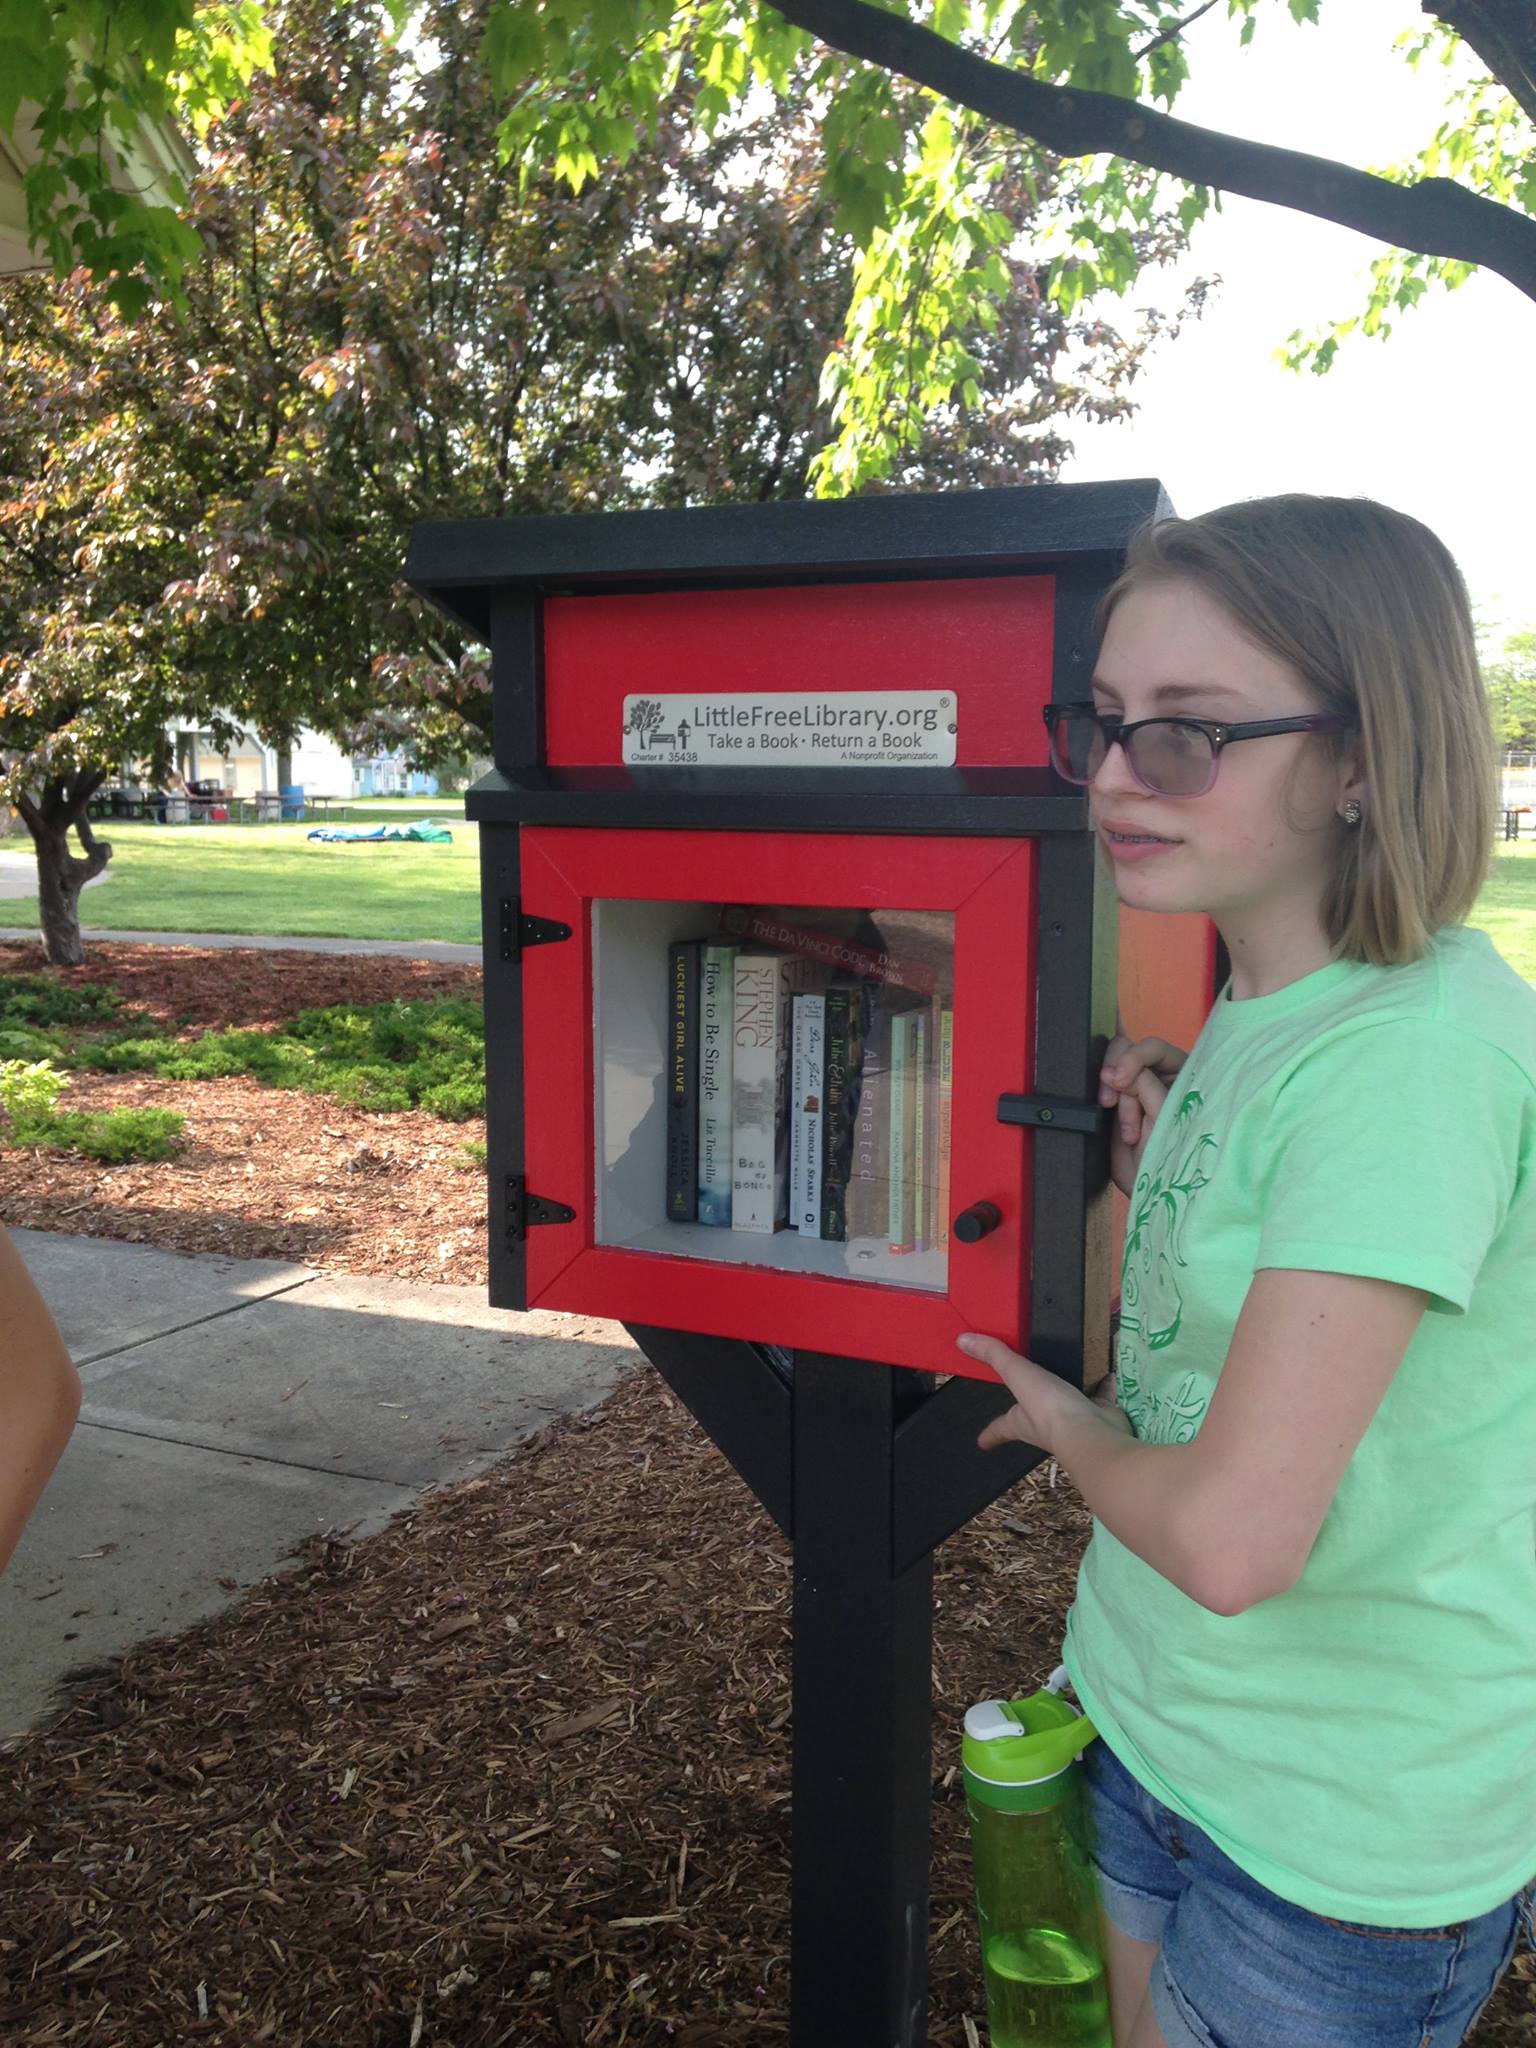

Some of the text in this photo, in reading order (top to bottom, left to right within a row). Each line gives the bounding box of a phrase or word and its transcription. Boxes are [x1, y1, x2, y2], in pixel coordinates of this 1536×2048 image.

[694, 703, 938, 731] LittleFreeLibrary.org
[708, 732, 922, 749] Take a Book Return a Book
[631, 753, 657, 762] Charter
[667, 752, 698, 762] 35438
[840, 750, 938, 761] A Nonprofit Organization
[752, 920, 778, 939] THE
[831, 944, 868, 968] CODE
[675, 955, 686, 1094] LUCKIEST GIRL ALIVE
[701, 961, 721, 1102] How to Be Single
[735, 969, 759, 1048] KING
[759, 968, 775, 1048] STEPHEN
[859, 1050, 880, 1182] Alienated
[680, 1131, 689, 1185] JESSICA
[705, 1117, 717, 1184] Liz Tuccillo
[807, 1118, 817, 1202] NICHOLAS SPARKS
